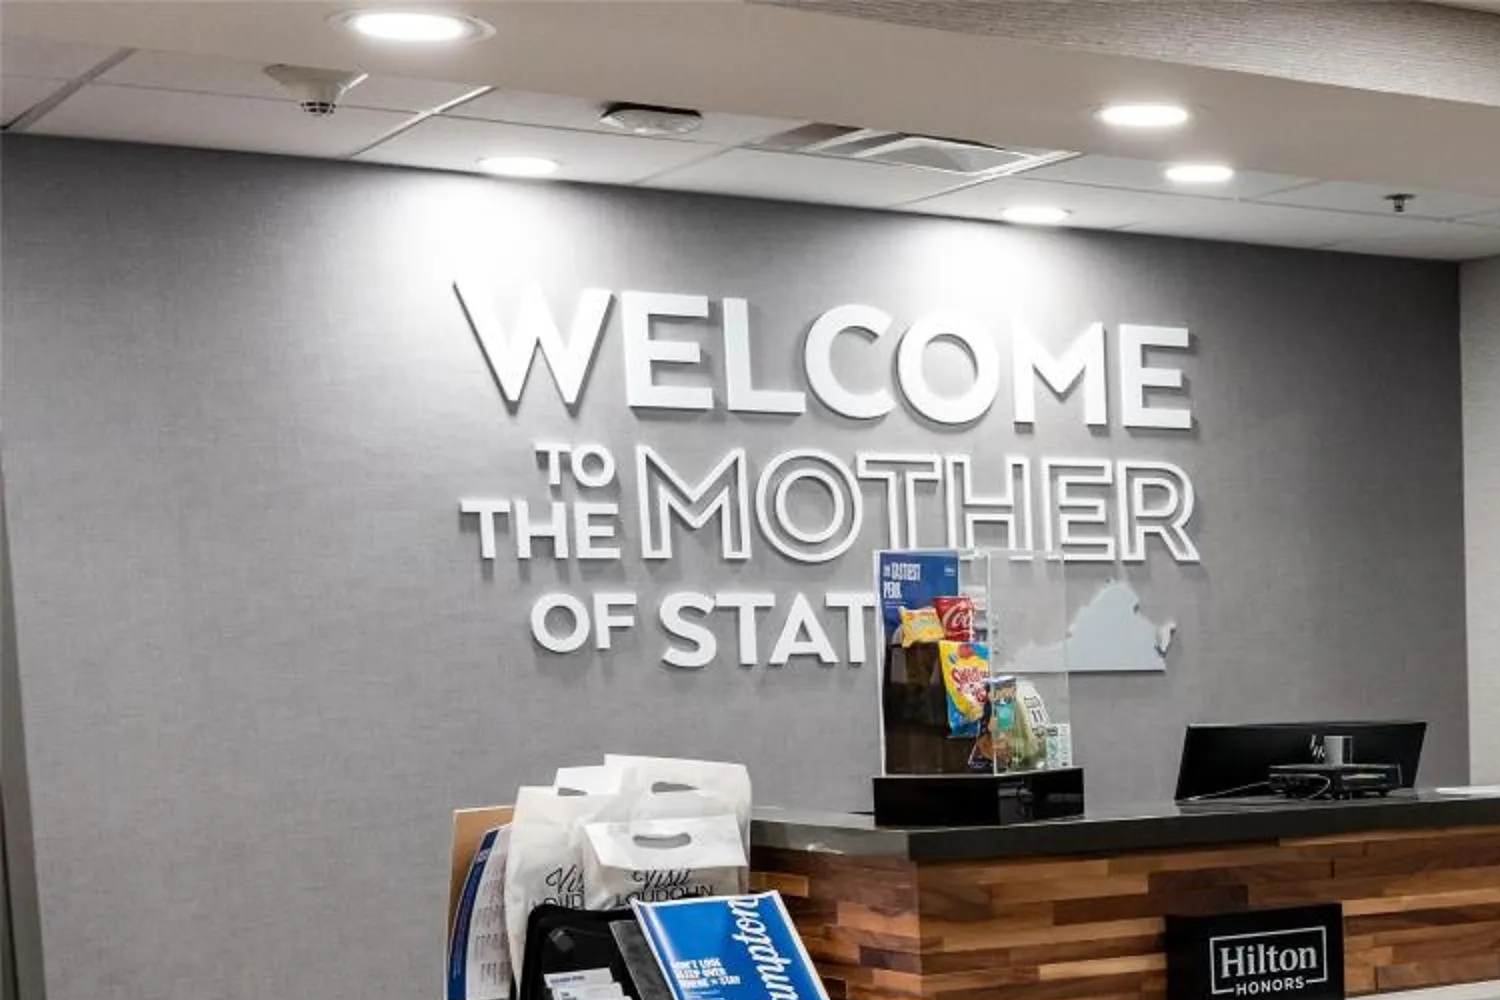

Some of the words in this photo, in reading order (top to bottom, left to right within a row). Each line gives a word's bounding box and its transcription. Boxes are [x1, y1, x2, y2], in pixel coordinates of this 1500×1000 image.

[453, 281, 1194, 429] WELCOME
[535, 443, 616, 488] TO
[461, 499, 621, 560] THE
[635, 446, 1200, 563] MOTHER
[530, 593, 638, 653] OF
[658, 591, 876, 668] STAT
[1220, 944, 1317, 978] Hilton
[1235, 976, 1305, 997] HONORS
